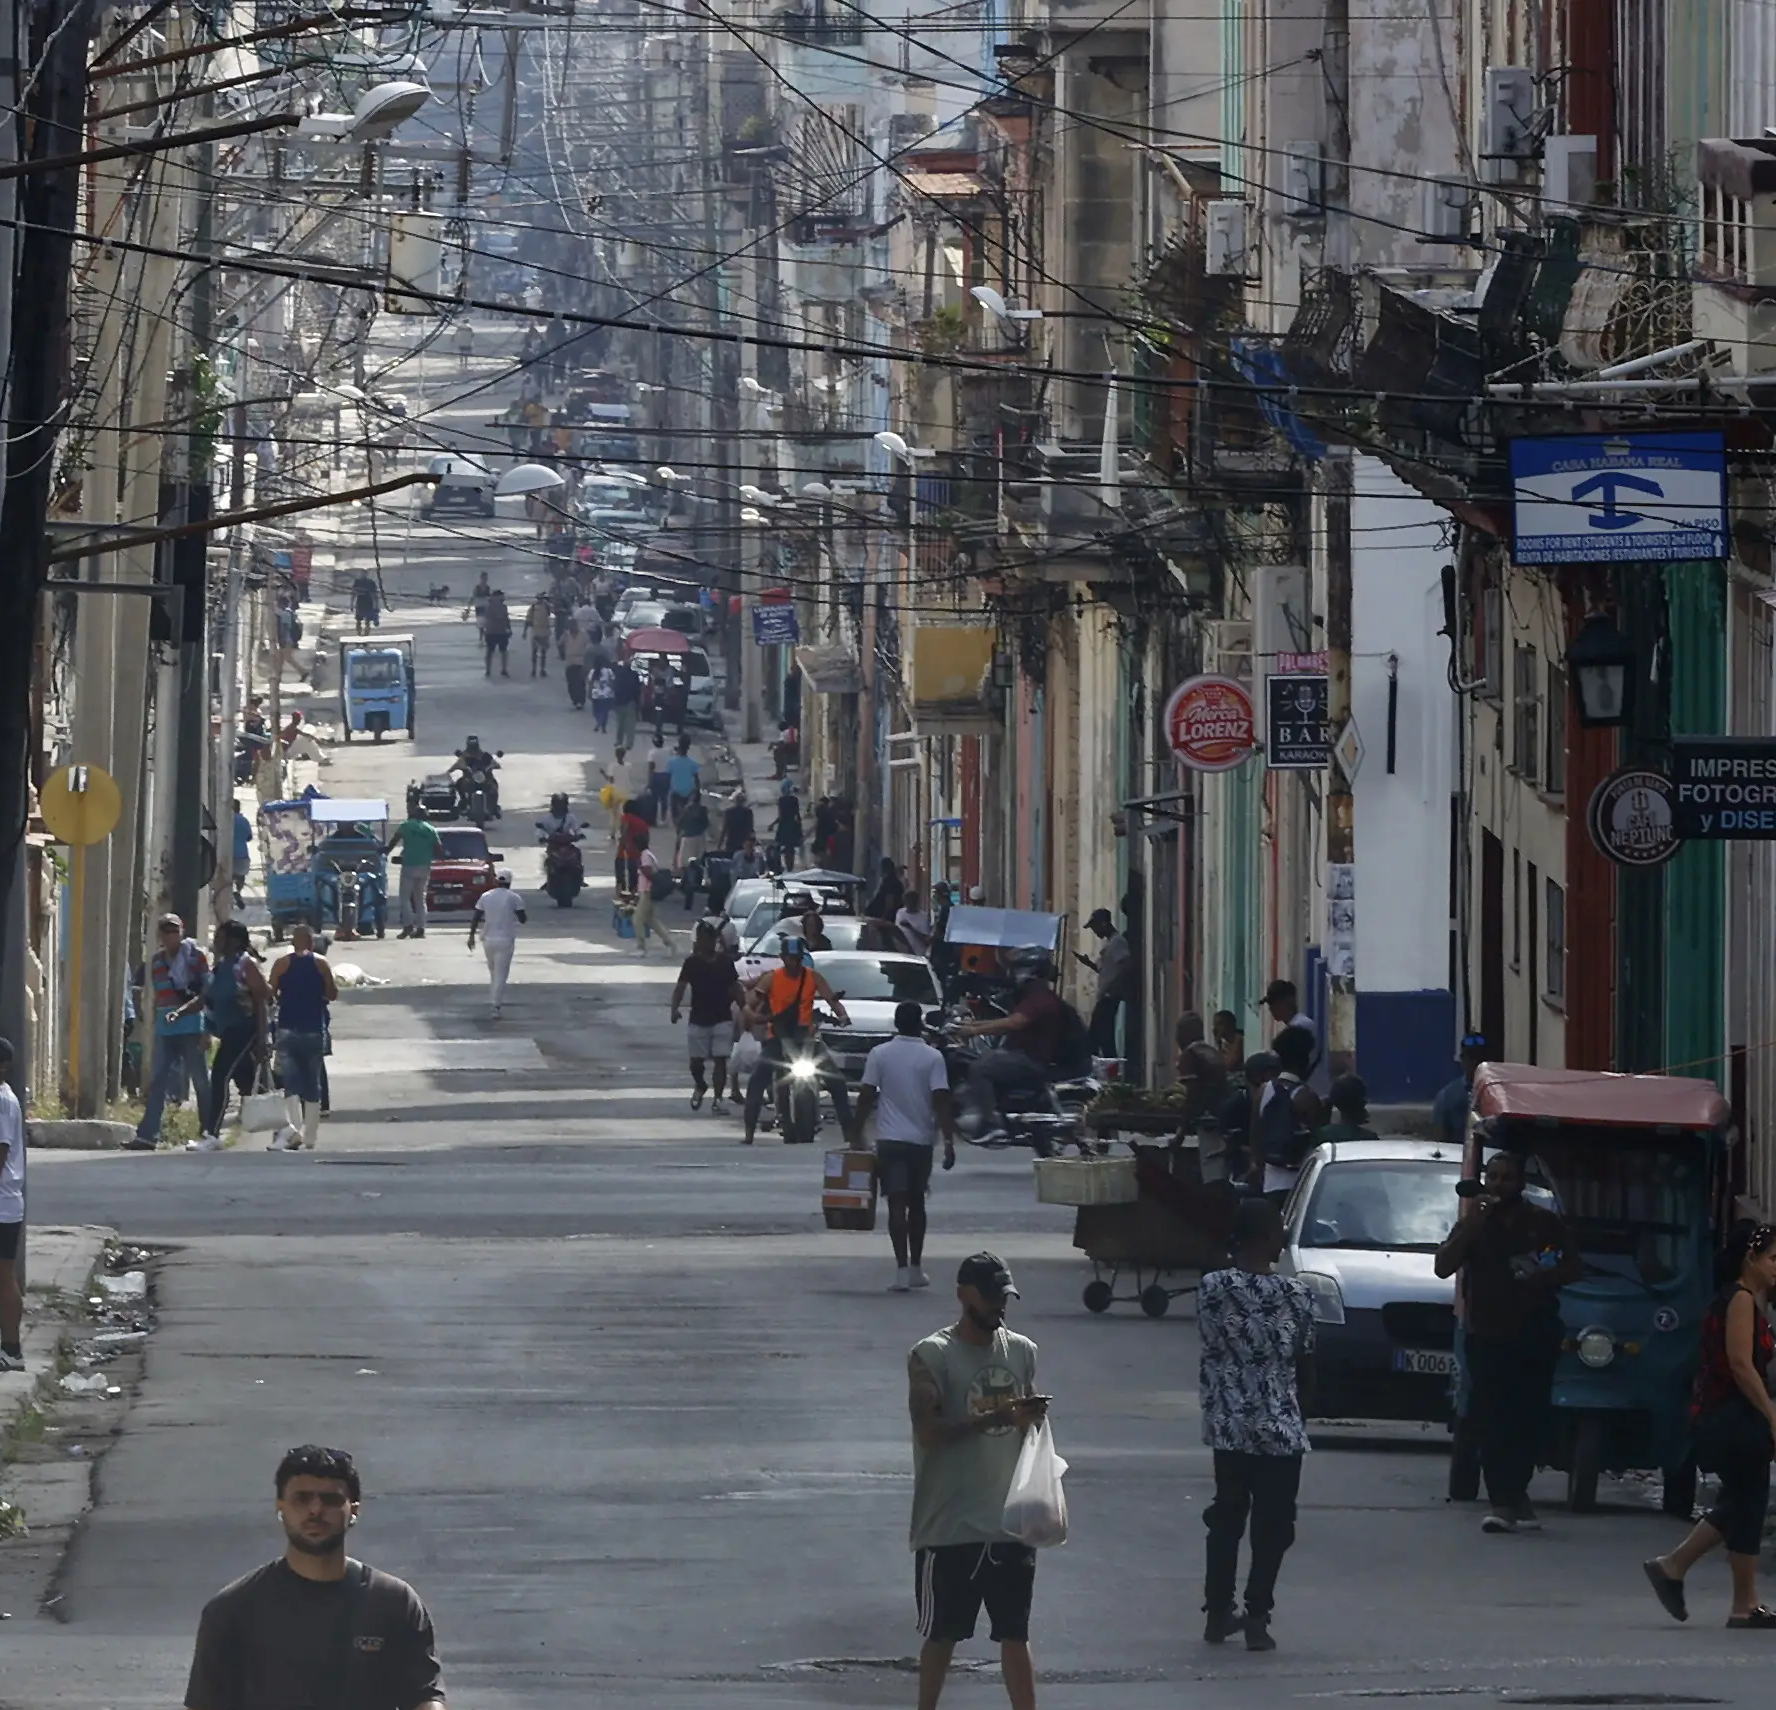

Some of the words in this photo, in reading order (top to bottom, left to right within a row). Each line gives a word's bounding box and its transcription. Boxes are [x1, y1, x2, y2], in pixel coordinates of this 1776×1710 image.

[1551, 459, 1588, 472] CASA
[1589, 456, 1645, 469] HABANA
[1647, 456, 1683, 469] REAL
[1179, 721, 1249, 742] LORENZ
[1700, 814, 1713, 833] y
